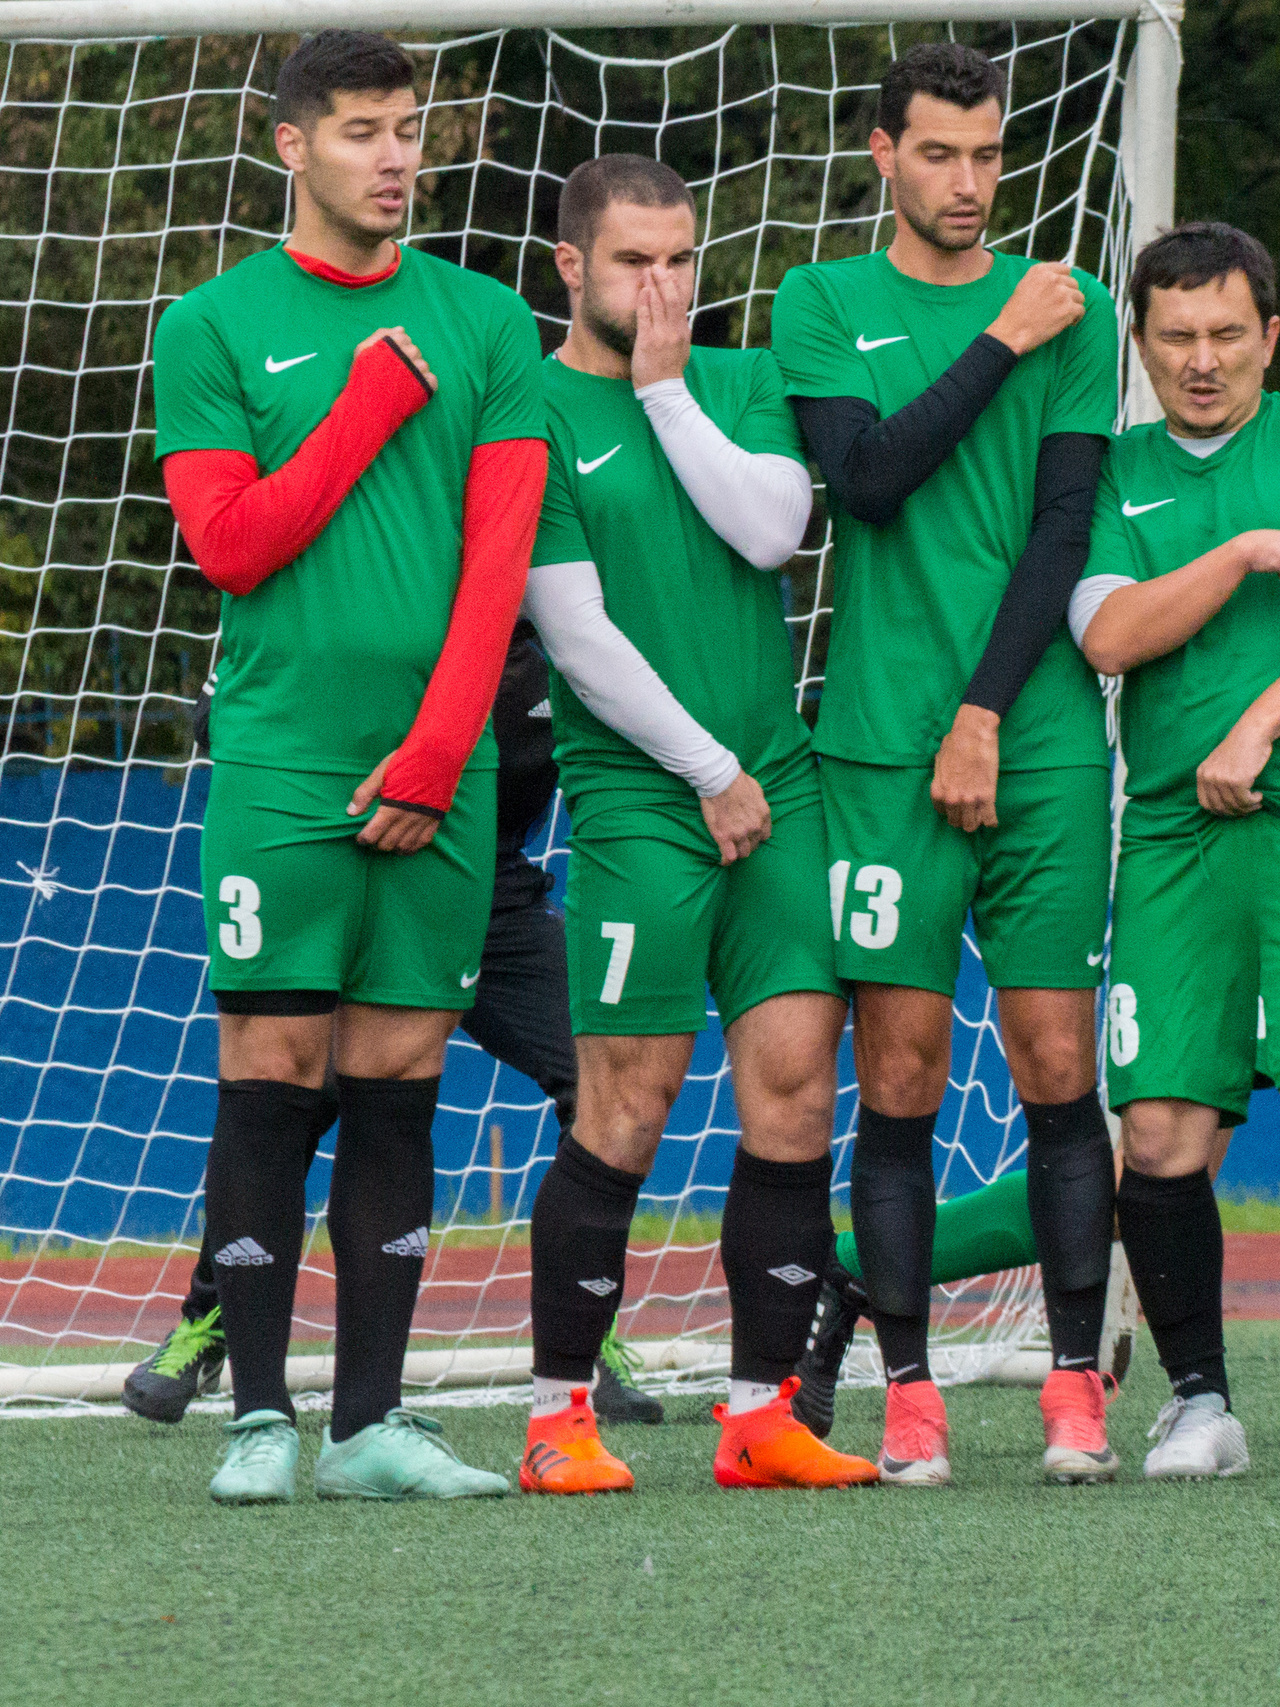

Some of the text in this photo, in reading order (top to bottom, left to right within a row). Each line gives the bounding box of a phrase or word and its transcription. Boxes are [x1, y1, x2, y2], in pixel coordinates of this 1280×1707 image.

[218, 875, 263, 960] 3
[828, 860, 903, 949] 13
[599, 921, 635, 1005] 7
[1108, 983, 1140, 1068] 8
[214, 1252, 274, 1267] adidas
